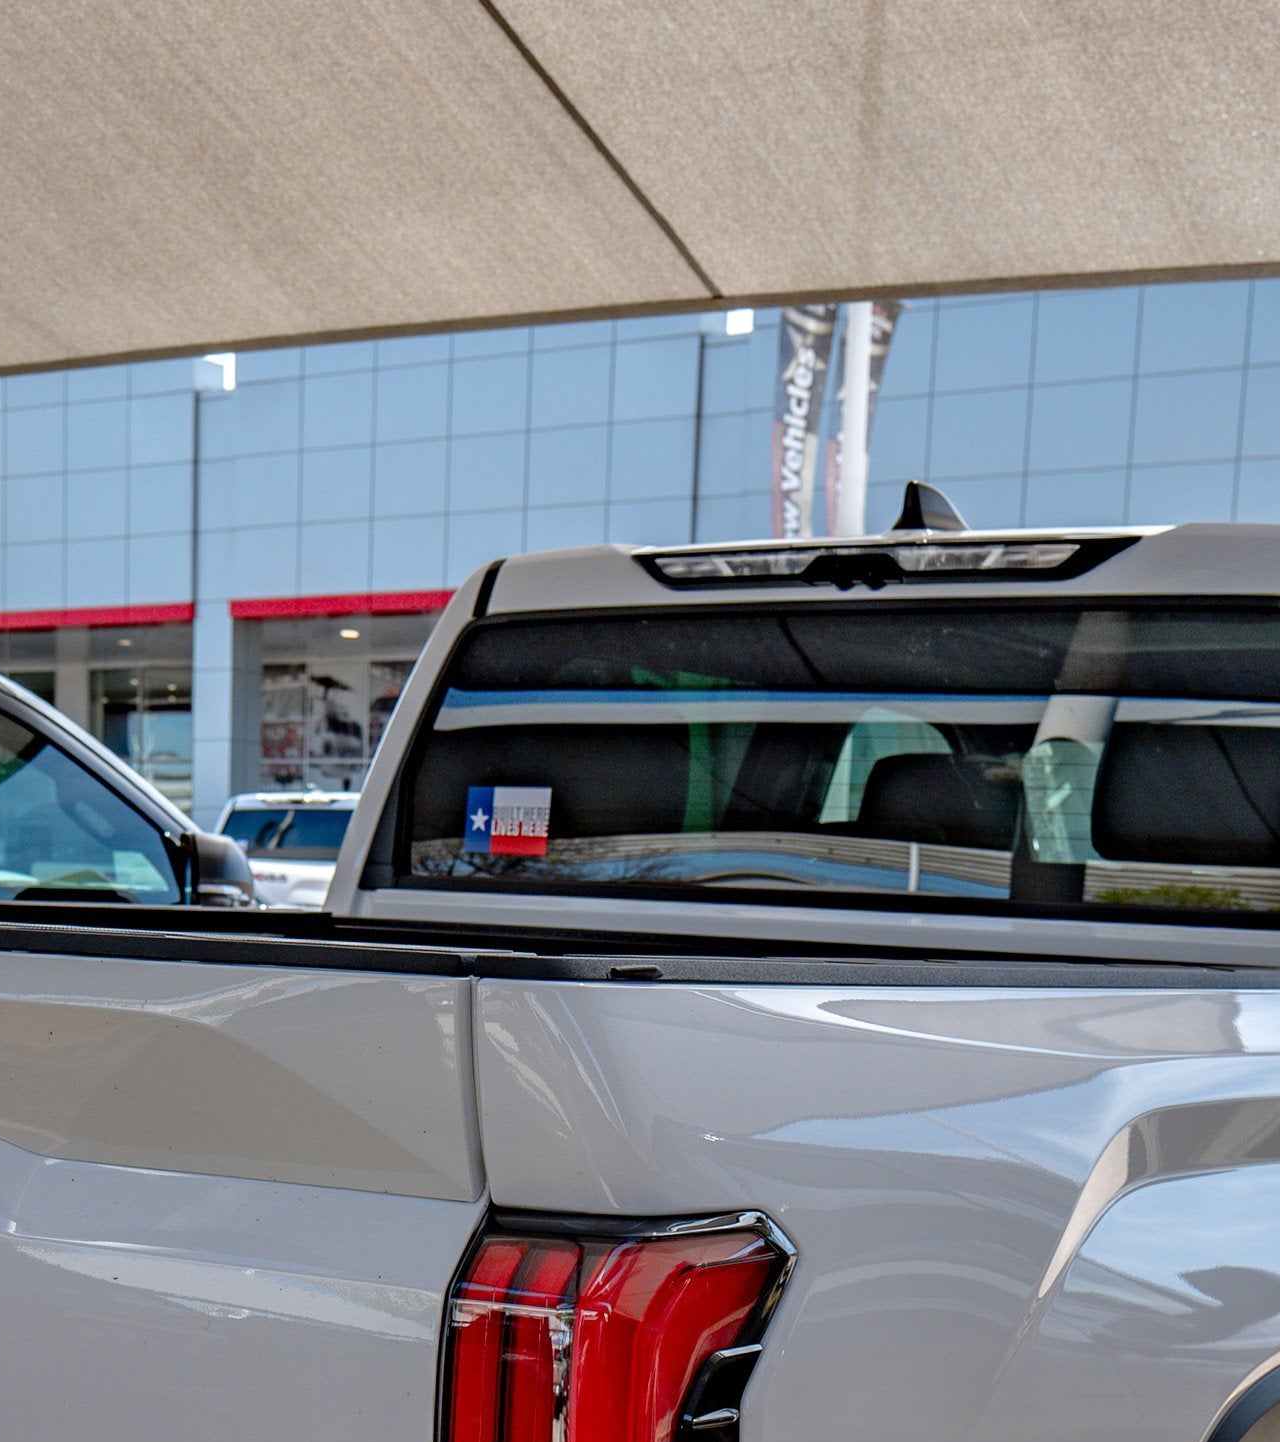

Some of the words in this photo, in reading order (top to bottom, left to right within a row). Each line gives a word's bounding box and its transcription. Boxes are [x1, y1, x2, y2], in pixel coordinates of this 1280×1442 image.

[781, 347, 816, 492] Vehicles
[523, 806, 550, 821] HERE
[521, 821, 549, 837] HERE
